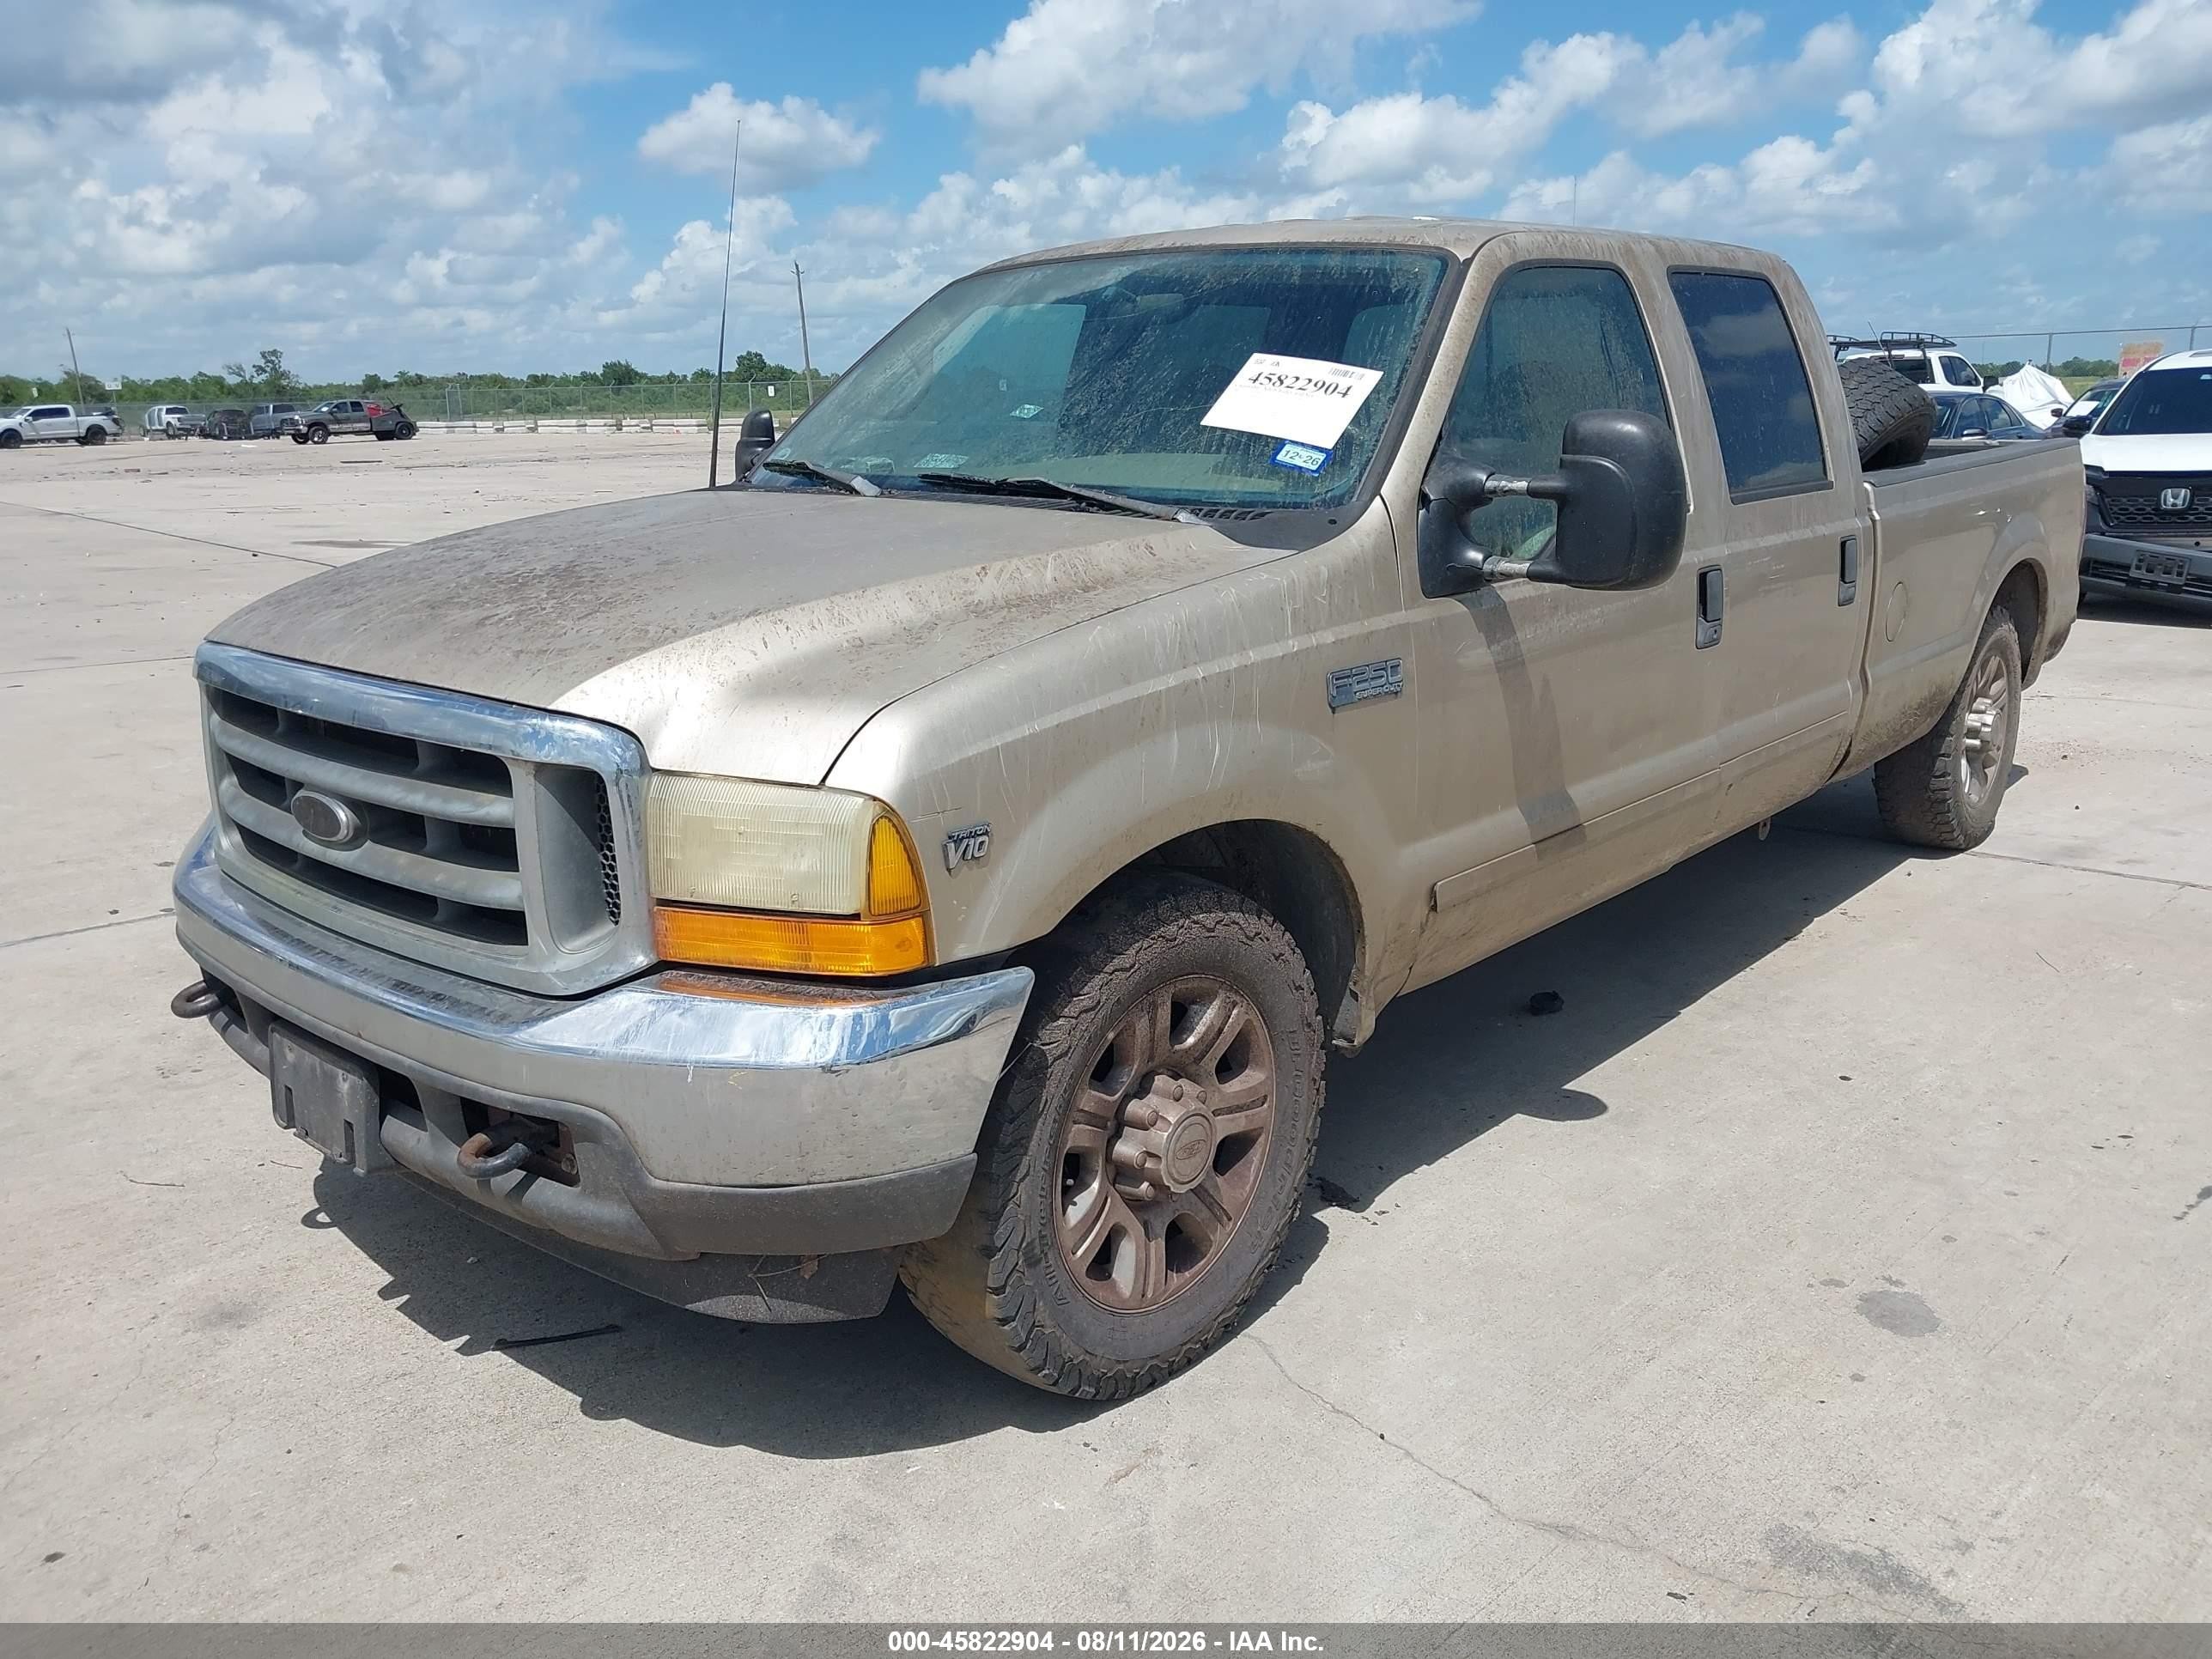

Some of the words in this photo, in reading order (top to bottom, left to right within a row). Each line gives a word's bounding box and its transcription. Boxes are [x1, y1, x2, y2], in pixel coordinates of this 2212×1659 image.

[1248, 371, 1353, 398] 45822904
[1355, 687, 1382, 700] SUPER
[1384, 682, 1404, 694] DUTY
[951, 823, 992, 841] TRITON
[945, 835, 989, 870] V10
